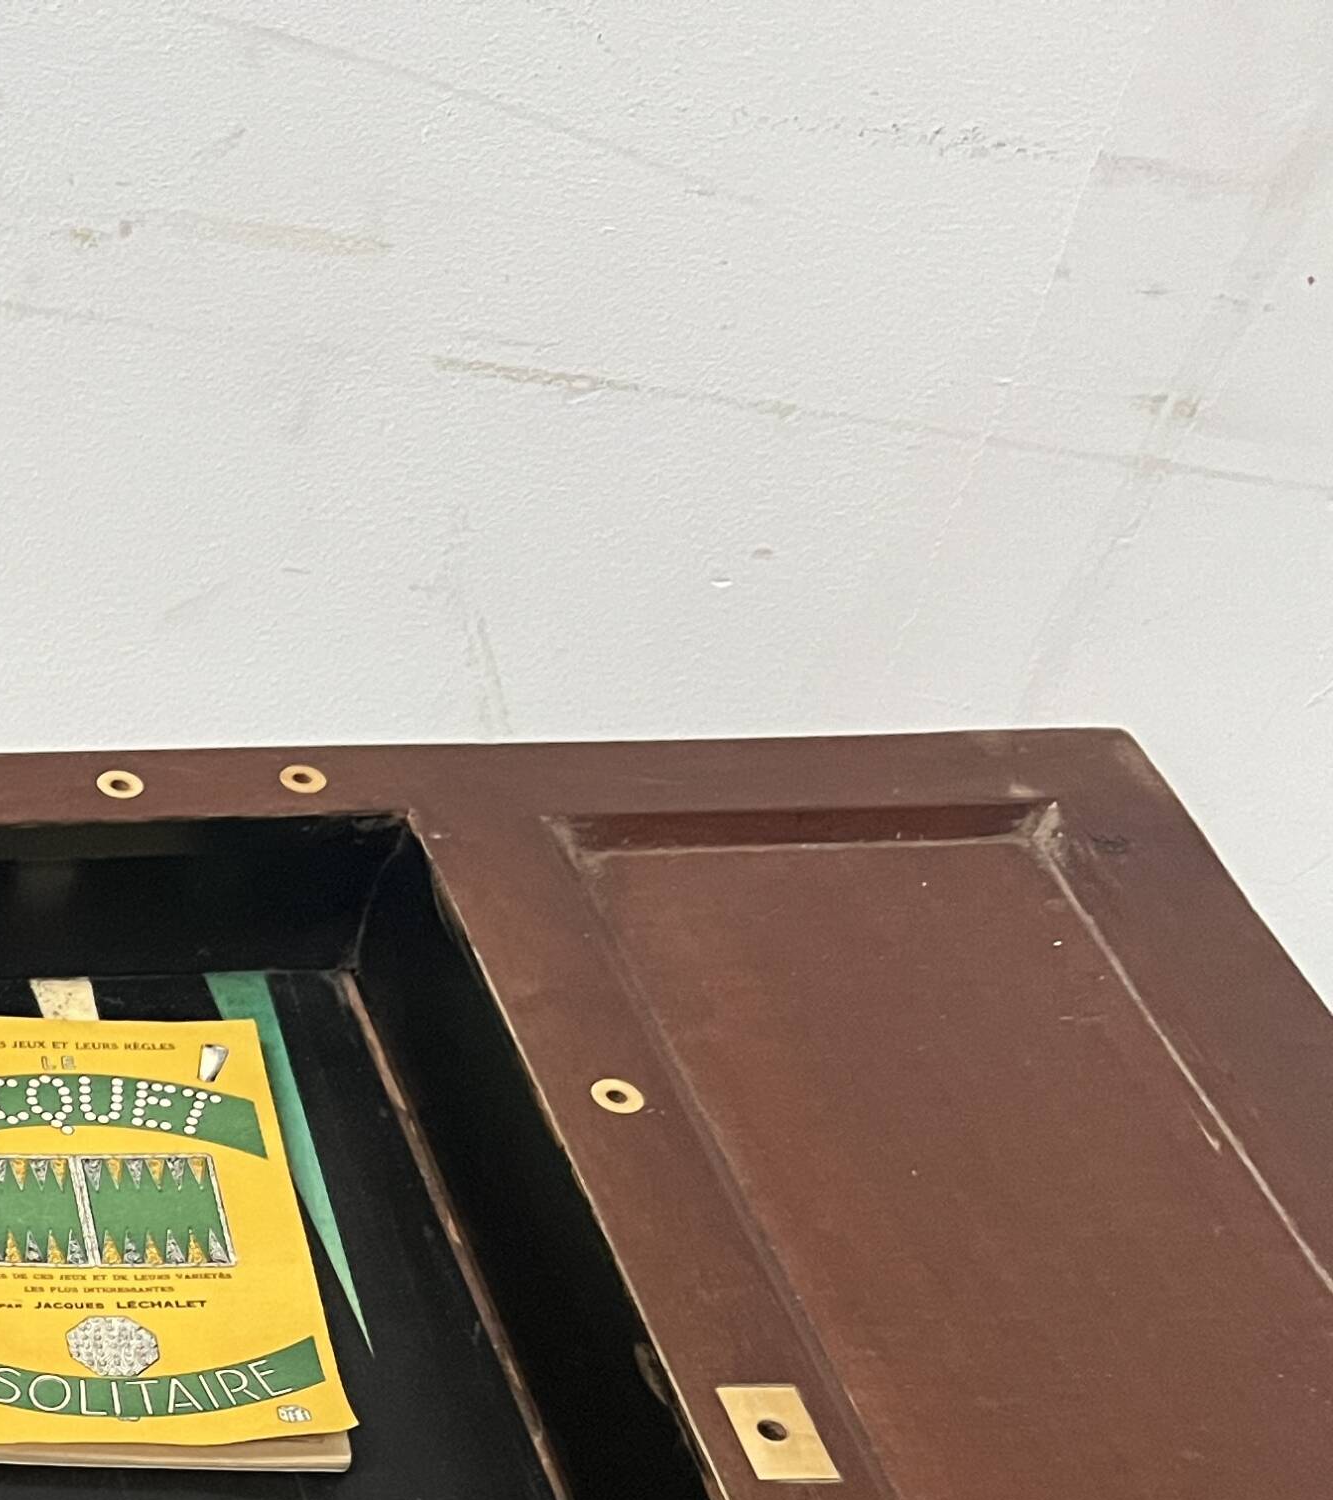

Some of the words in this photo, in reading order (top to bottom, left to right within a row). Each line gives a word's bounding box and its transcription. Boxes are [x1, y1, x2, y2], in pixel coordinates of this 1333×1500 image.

[12, 1040, 46, 1049] JEUX
[52, 1041, 69, 1050] ET
[75, 1041, 119, 1050] LEURS
[41, 1055, 76, 1070] LE
[34, 1301, 104, 1310] JACQUES
